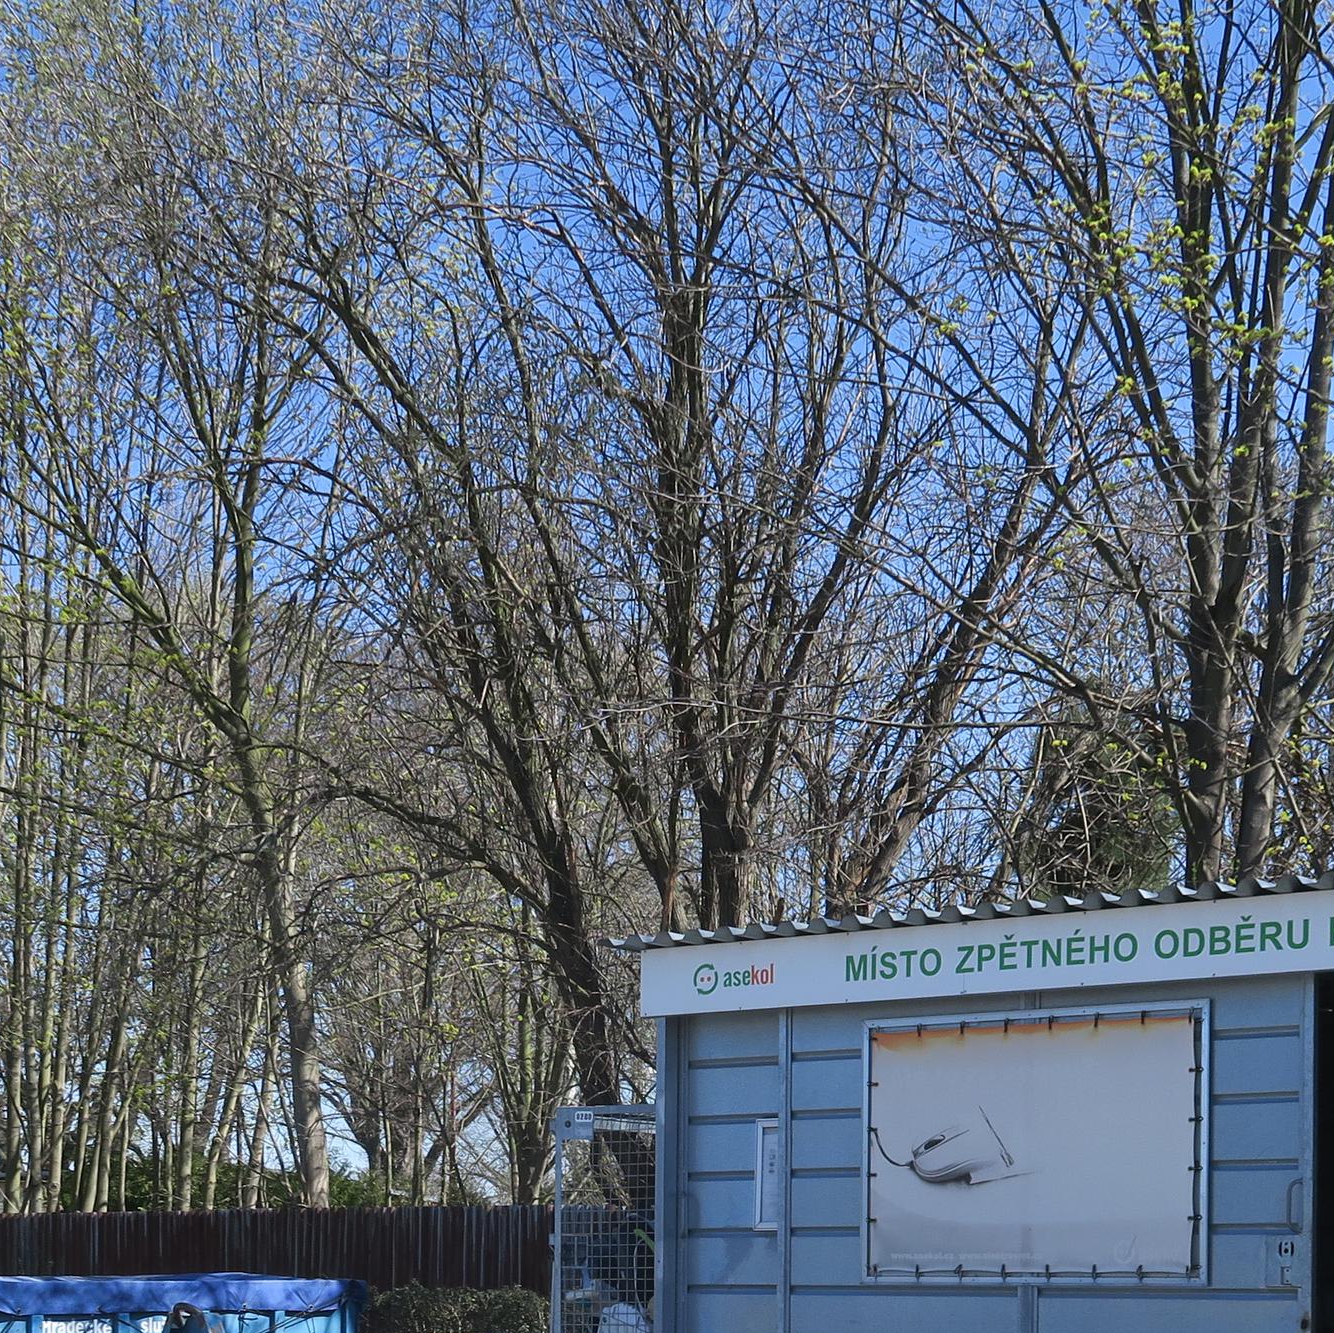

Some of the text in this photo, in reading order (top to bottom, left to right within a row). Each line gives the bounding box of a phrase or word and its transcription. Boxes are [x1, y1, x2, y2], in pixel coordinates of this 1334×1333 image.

[845, 945, 942, 983] MÍSTO
[955, 928, 1139, 974] ZPĚTNÉHO
[1154, 914, 1310, 960] ODBĚRU
[723, 963, 774, 988] asekol
[140, 1317, 166, 1333] slu
